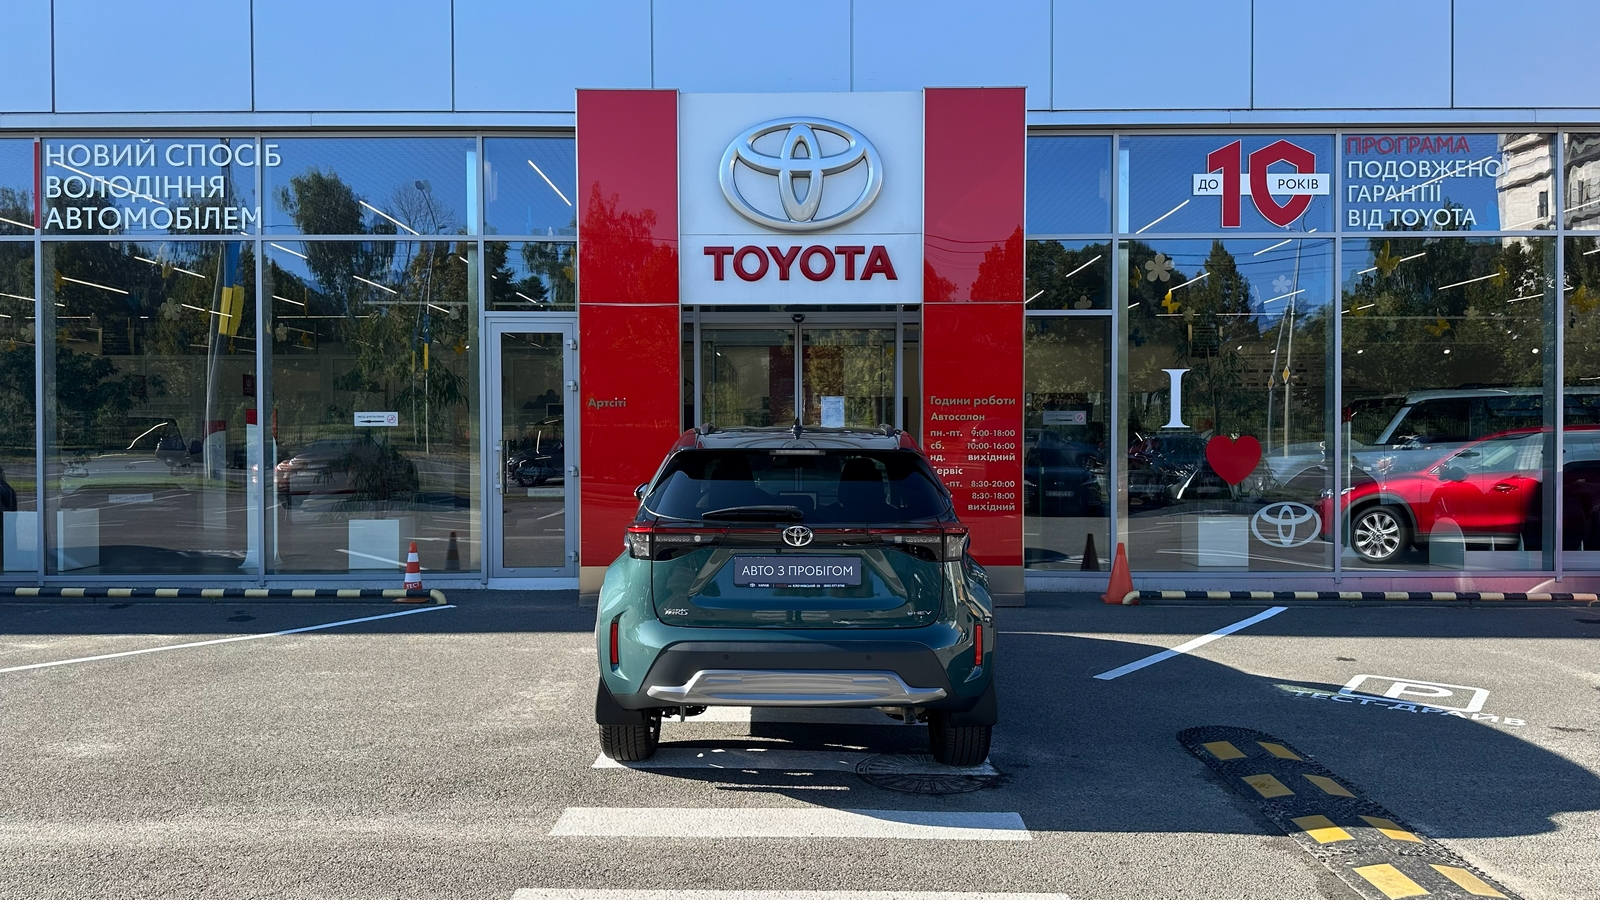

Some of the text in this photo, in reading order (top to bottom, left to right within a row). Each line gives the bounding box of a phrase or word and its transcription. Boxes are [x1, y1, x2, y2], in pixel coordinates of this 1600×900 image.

[1346, 136, 1470, 154] ПРОГРАМА
[45, 139, 282, 167] НОВИЙ СПОСІБ
[46, 175, 225, 203] ВОЛОДІННЯ
[1197, 138, 1319, 228] ДО 10 РОКІВ
[1348, 180, 1443, 202] ГАРАНТІЇ
[44, 206, 262, 229] АВТОМОБІЛЕМ
[1348, 208, 1477, 230] ВІД TOYOTA
[703, 245, 898, 282] TOYOTA
[588, 397, 626, 410] Артсіті
[930, 395, 1016, 407] Години роботи
[930, 412, 985, 421] Автосалон
[970, 429, 1016, 437] 9:00-18:00
[930, 440, 1016, 450] сб. 10:00-16:00
[930, 452, 1016, 462] нд. вихідний
[933, 466, 963, 477] ервіс
[971, 480, 1015, 488] 8:30-20:00
[971, 492, 1015, 500] 8:30-18:00
[967, 502, 1015, 512] вихідний
[741, 565, 853, 576] АВТО З ПРОБІГОМ
[1294, 690, 1527, 727] ТЕСТ-ДРАЙВ
